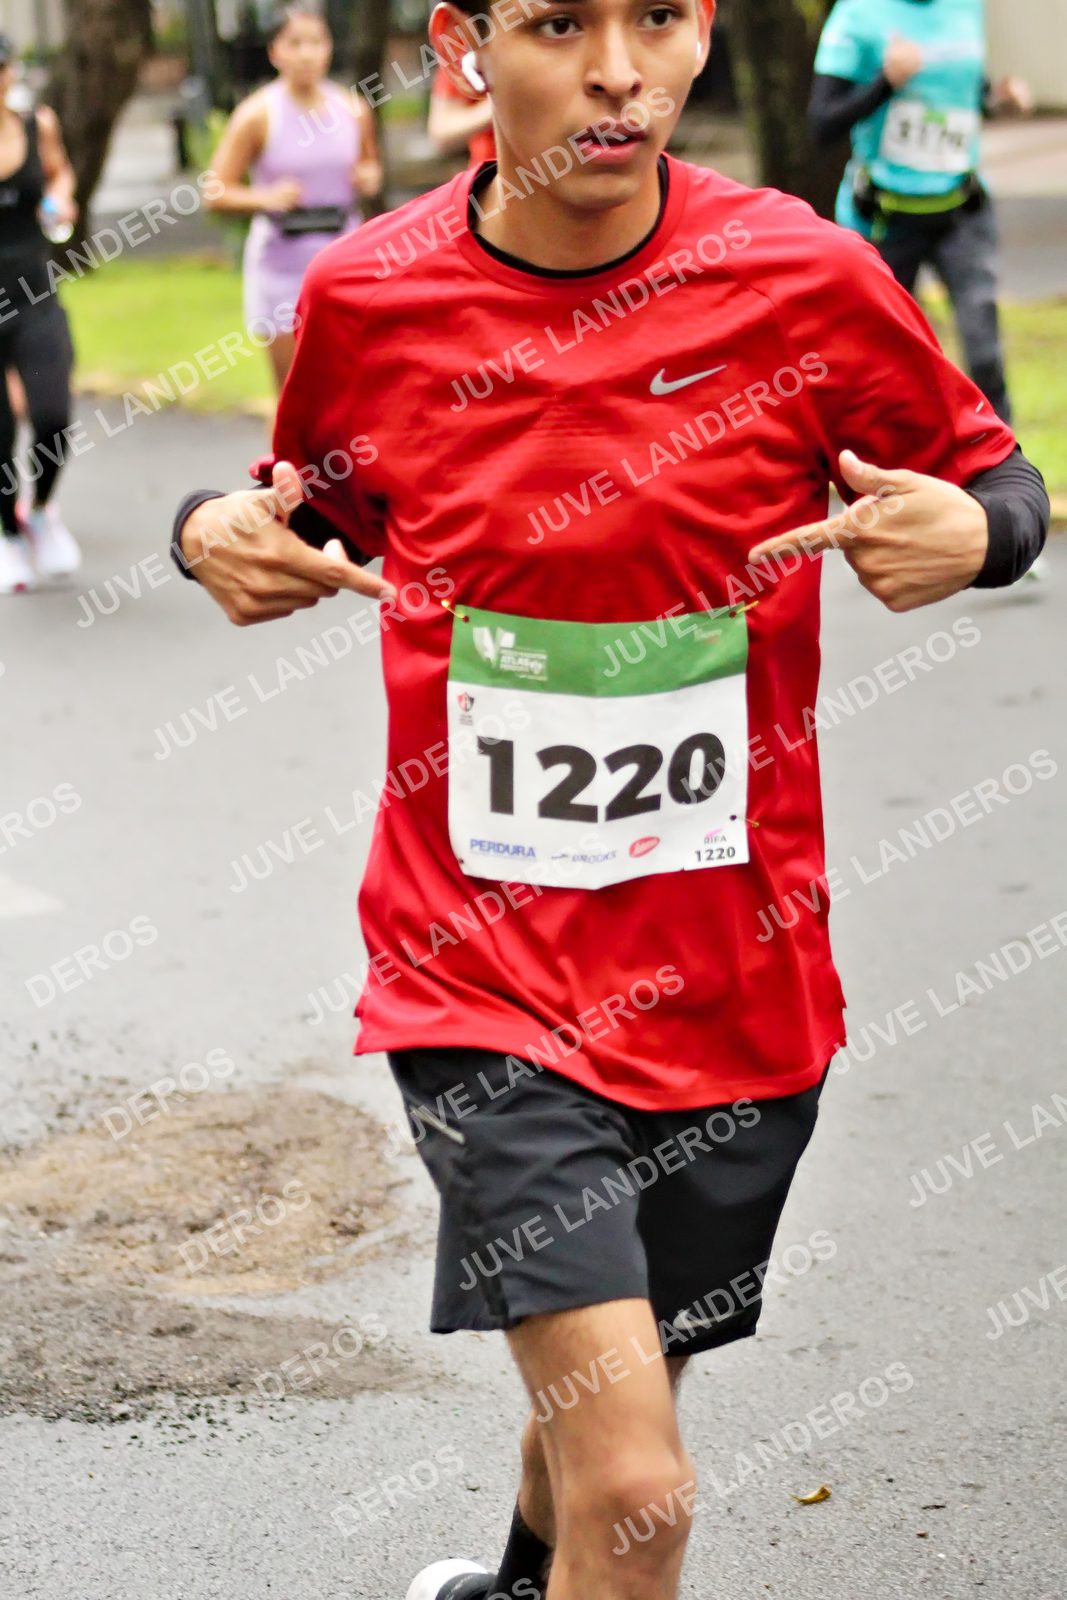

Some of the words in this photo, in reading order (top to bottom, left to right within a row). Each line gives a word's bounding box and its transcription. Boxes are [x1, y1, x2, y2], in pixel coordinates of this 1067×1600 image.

[477, 733, 726, 823] 1220
[469, 838, 536, 858] PERDURA
[704, 835, 727, 845] RIFA
[695, 846, 736, 862] 1220
